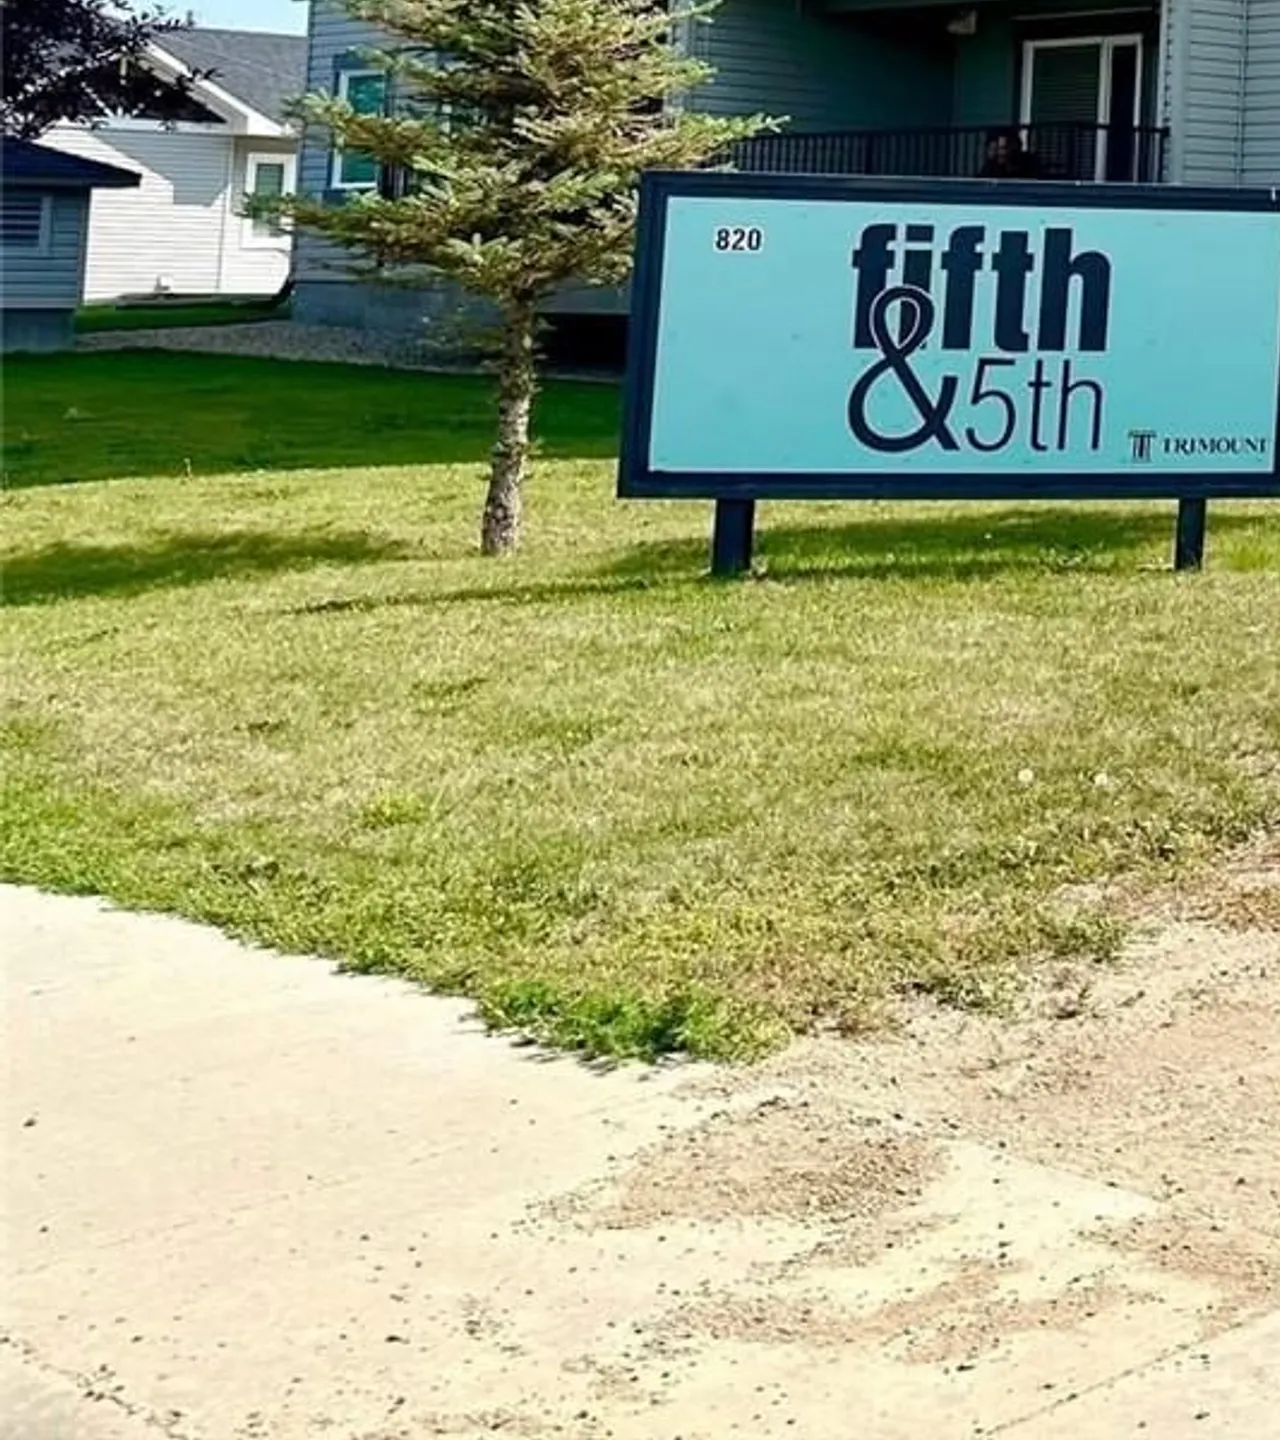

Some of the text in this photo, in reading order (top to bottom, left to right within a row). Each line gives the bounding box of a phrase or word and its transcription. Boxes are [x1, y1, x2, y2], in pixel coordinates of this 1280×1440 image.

[715, 226, 762, 252] 820
[852, 223, 1112, 352] fifth
[1163, 436, 1267, 455] TRIMOUNT
